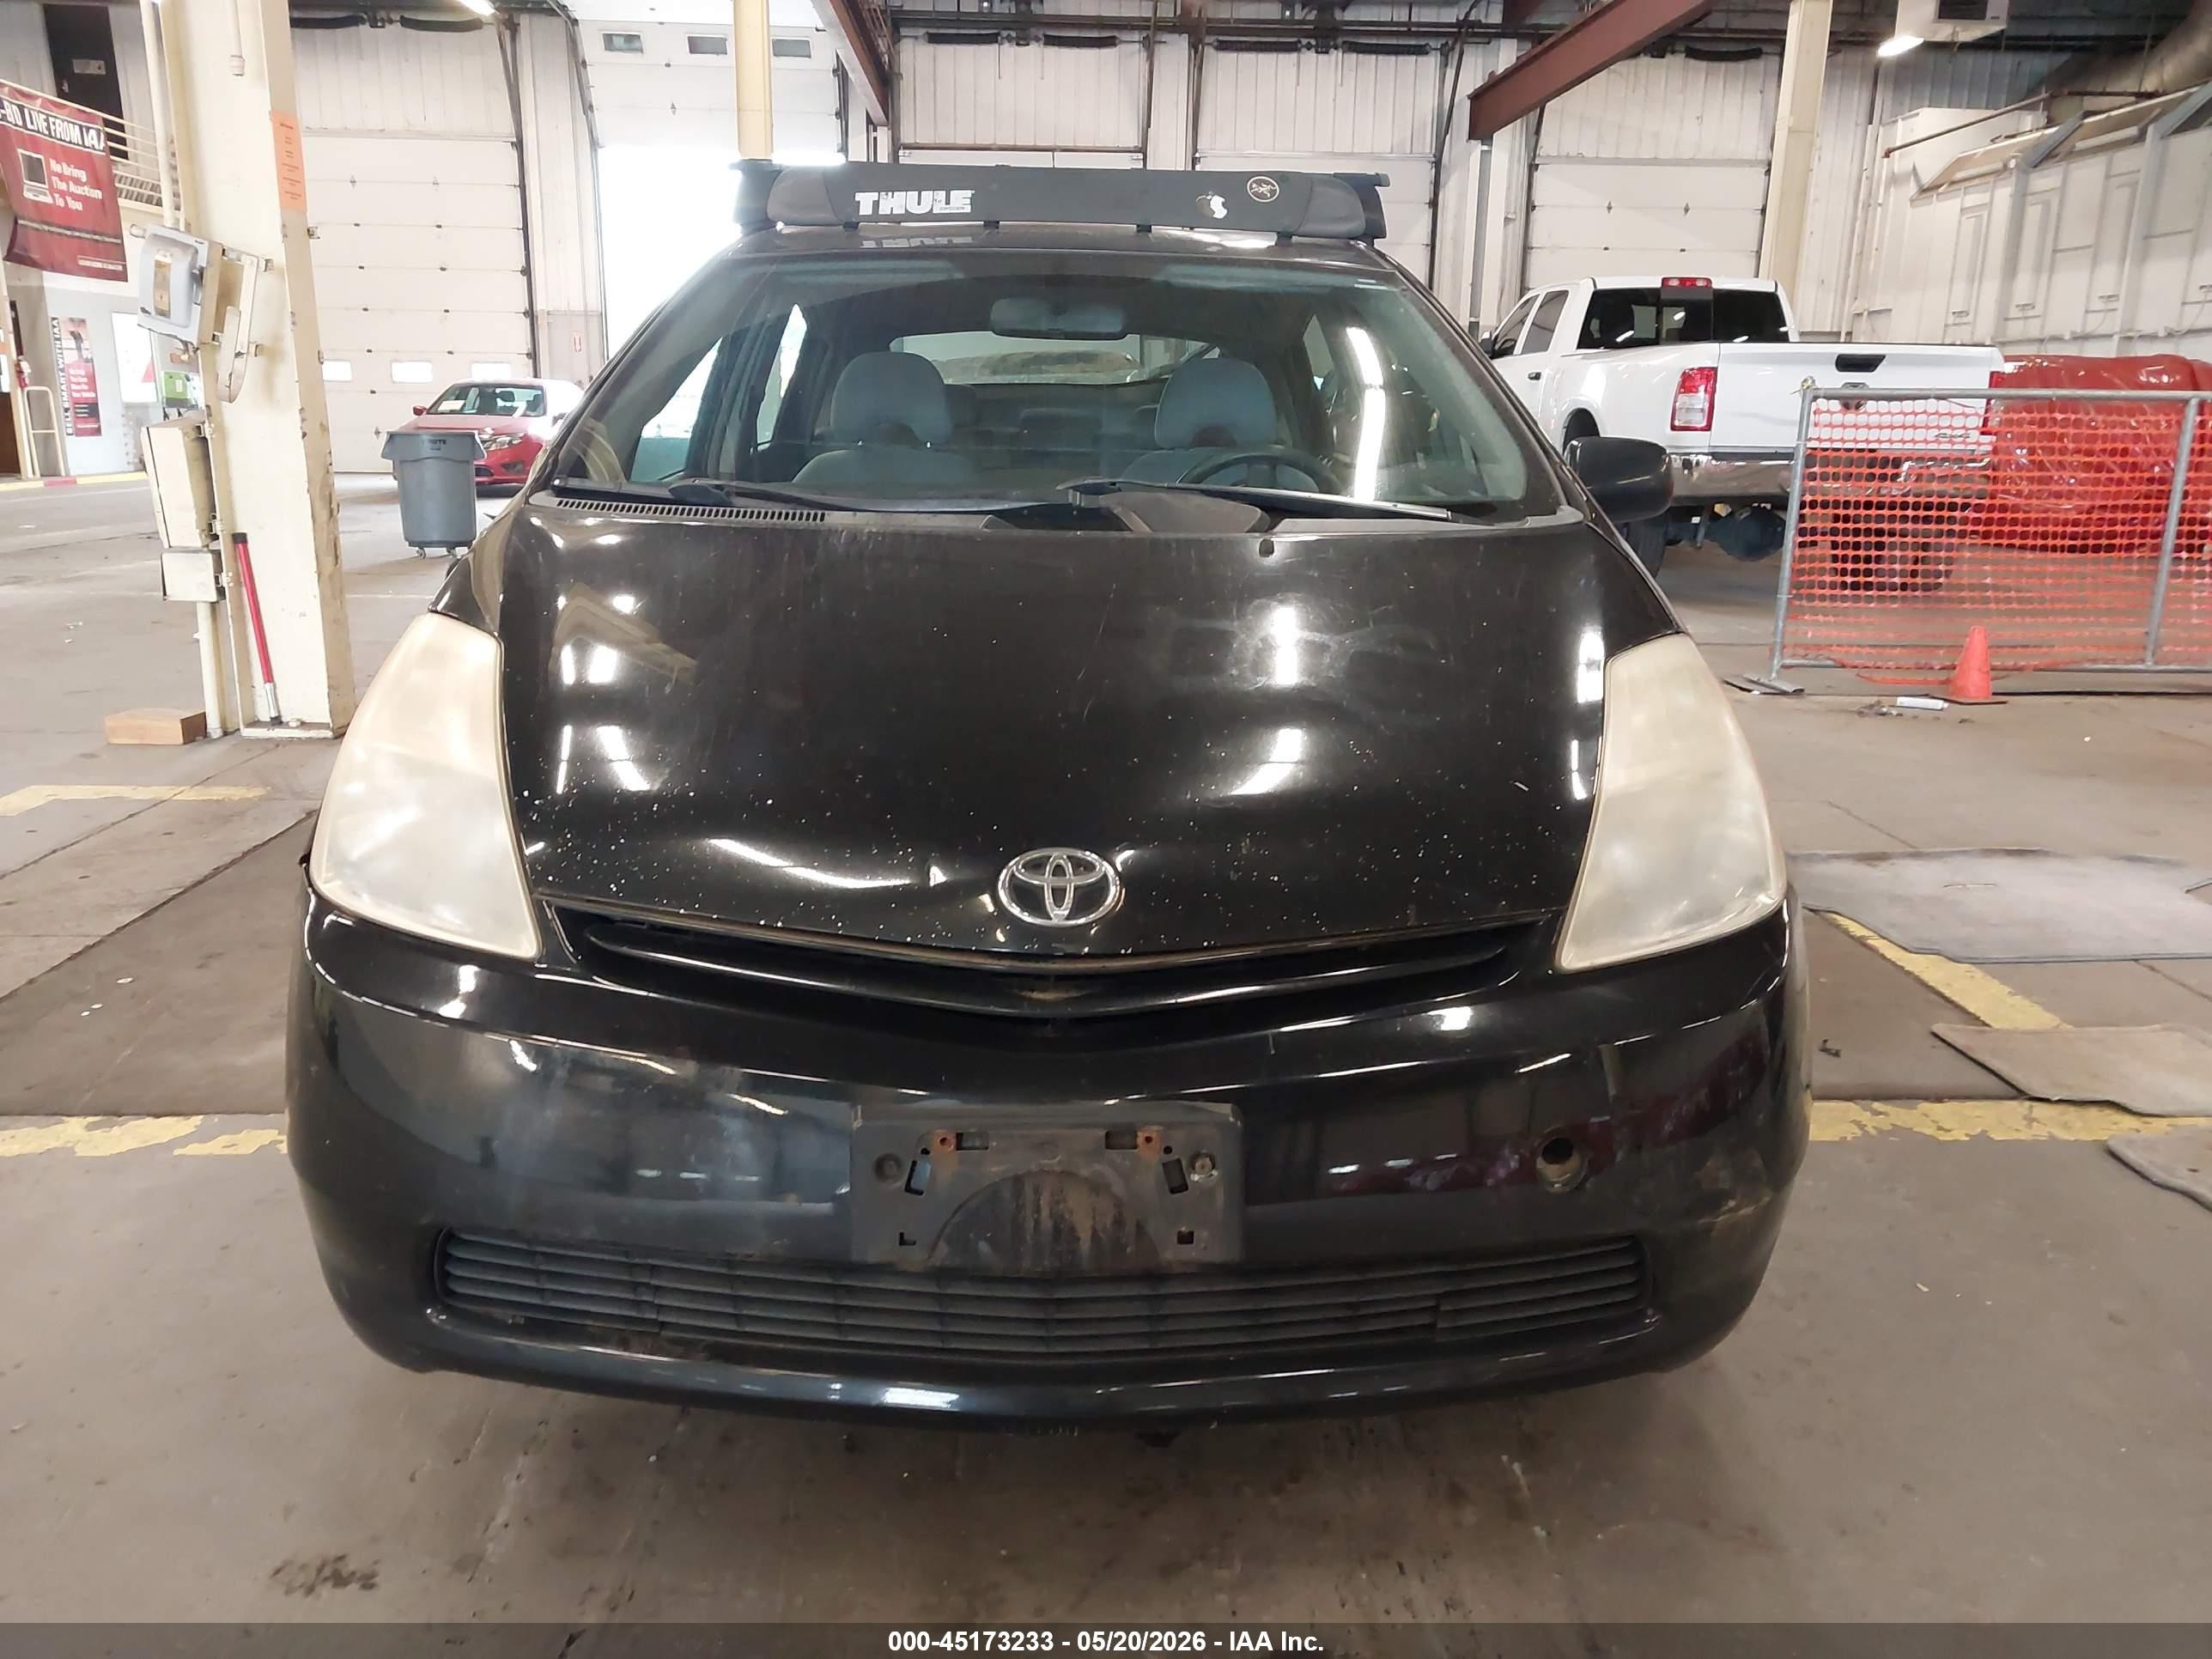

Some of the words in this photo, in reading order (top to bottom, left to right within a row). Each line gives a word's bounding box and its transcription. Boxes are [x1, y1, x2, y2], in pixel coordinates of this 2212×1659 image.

[24, 108, 49, 135] LIVE
[49, 116, 82, 145] FROM
[69, 181, 103, 199] Auction
[53, 193, 64, 208] To
[65, 196, 83, 210] You
[855, 190, 975, 215] THULE
